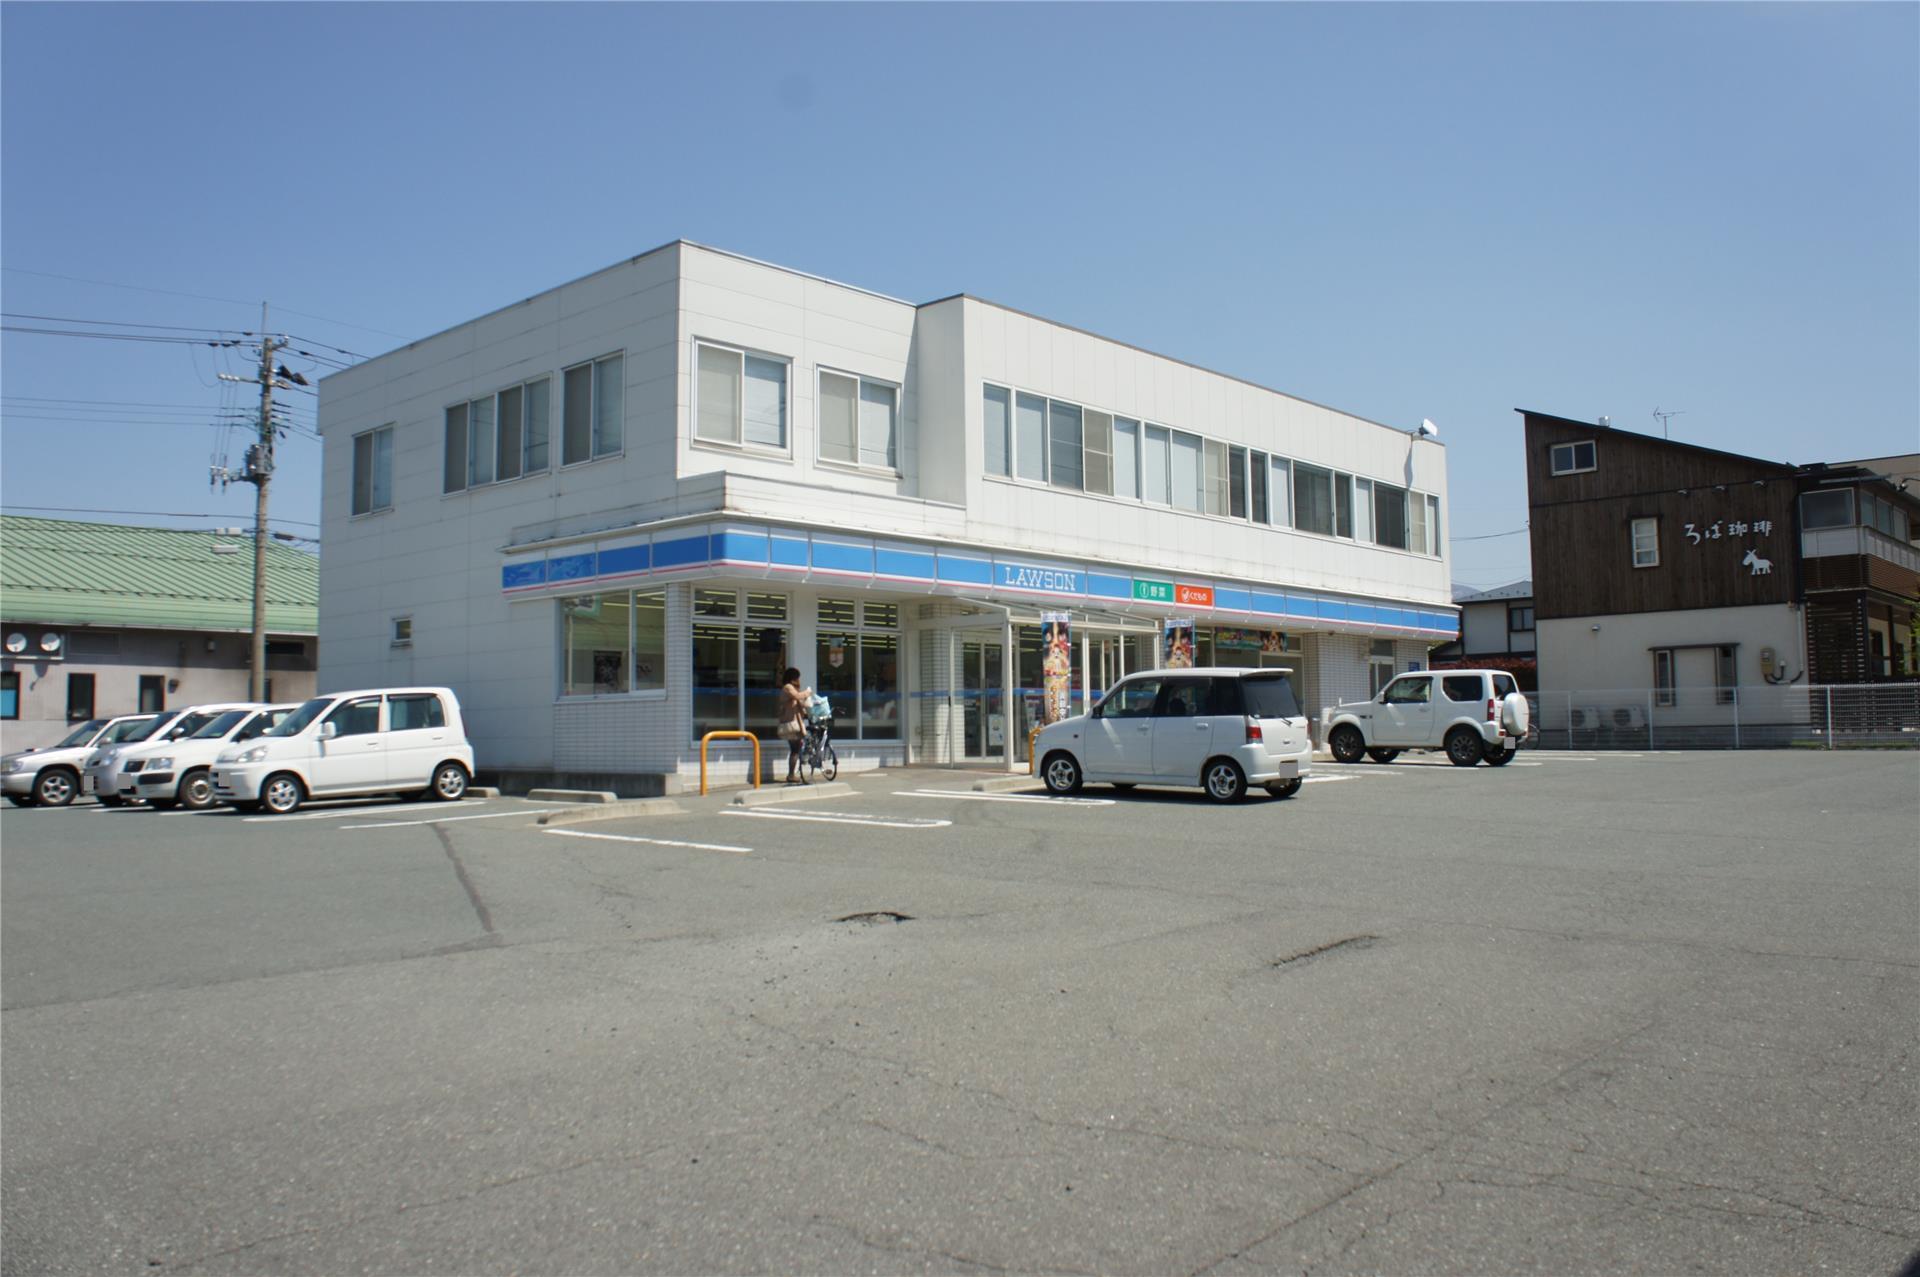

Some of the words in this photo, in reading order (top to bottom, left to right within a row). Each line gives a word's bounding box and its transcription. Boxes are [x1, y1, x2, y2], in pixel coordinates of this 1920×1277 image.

[1684, 520, 1773, 545] ろば珈琲
[1005, 567, 1075, 591] LAWSON
